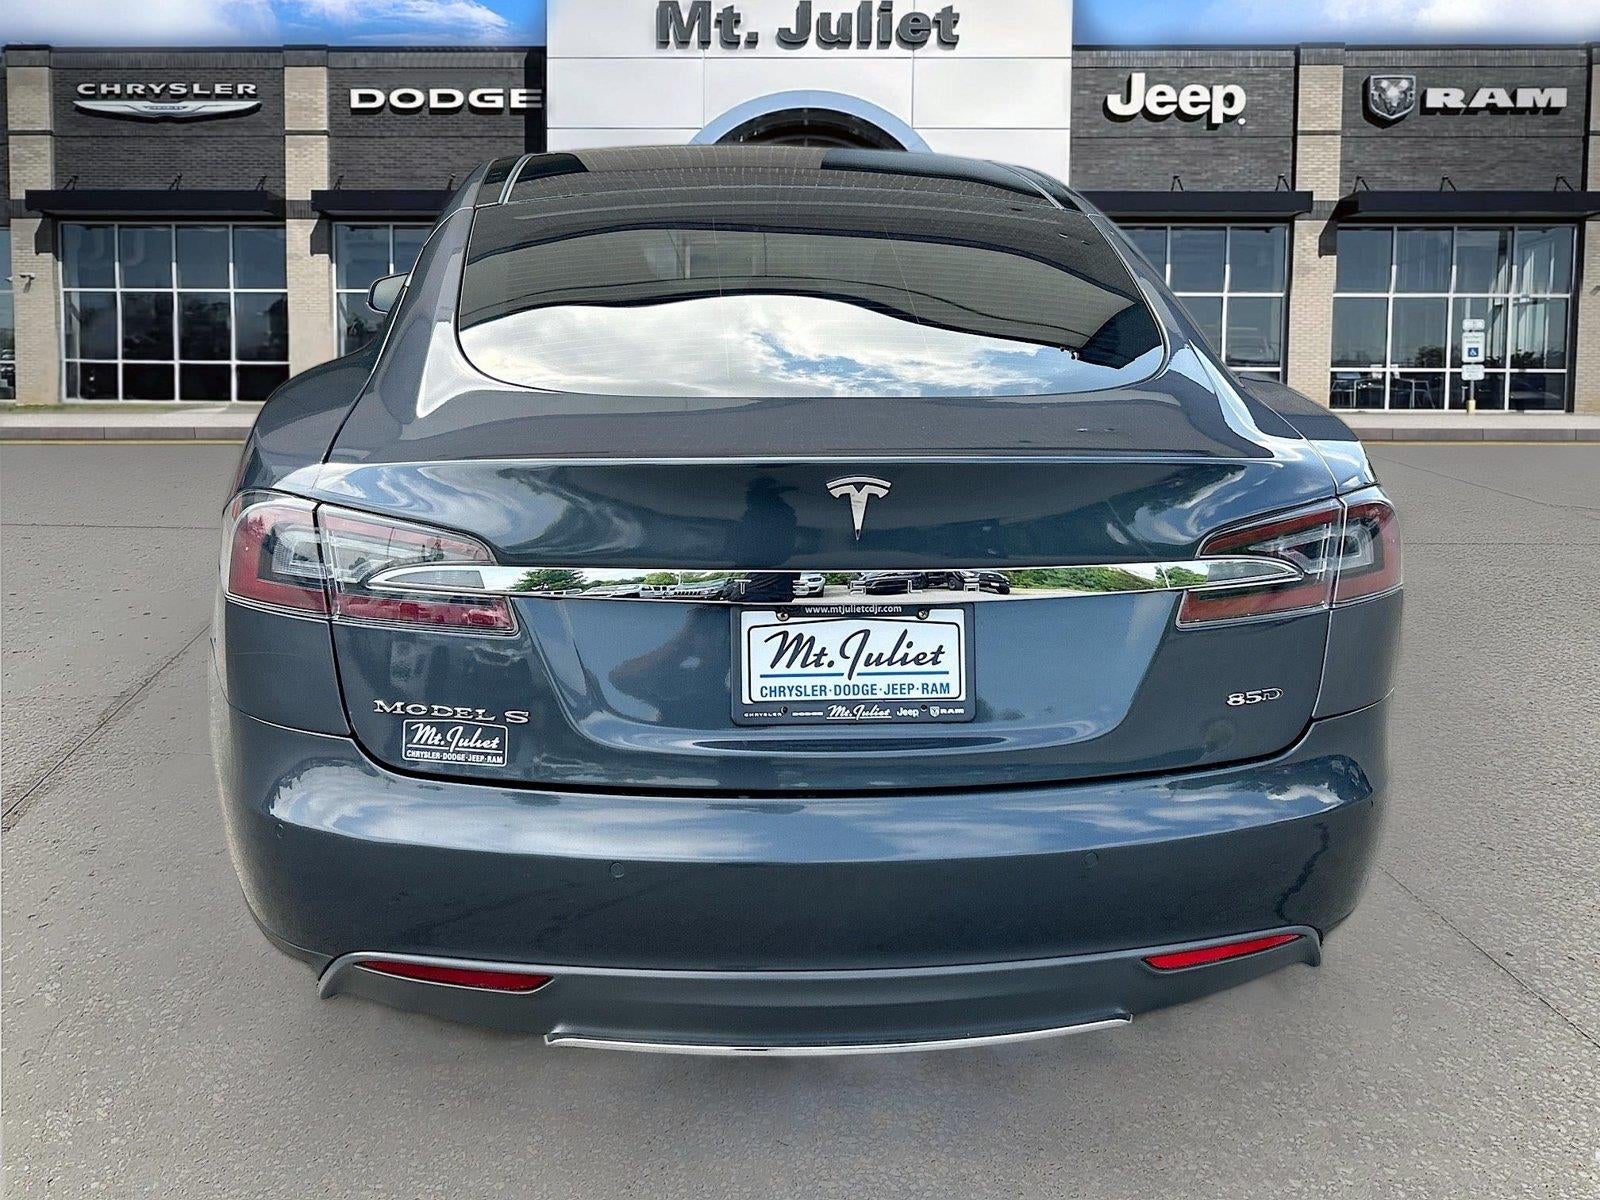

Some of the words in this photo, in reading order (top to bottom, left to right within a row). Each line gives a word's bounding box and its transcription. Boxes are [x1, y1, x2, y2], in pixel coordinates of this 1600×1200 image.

[656, 0, 759, 49] Mt.
[777, 0, 960, 49] Juliet
[76, 83, 257, 95] CHRYSLER
[350, 88, 543, 109] DODGE
[1106, 72, 1247, 125] Jeep
[1425, 87, 1568, 108] RAM
[805, 604, 902, 615] www.mtjulietcdjr.com
[764, 630, 835, 669] Mt.
[839, 628, 946, 681] Juliet
[1226, 687, 1284, 706] 85D
[373, 699, 496, 722] MODEL
[504, 710, 530, 724] S
[897, 706, 919, 718] Jeep
[411, 723, 445, 745] Mt.
[447, 725, 500, 752] Juliet
